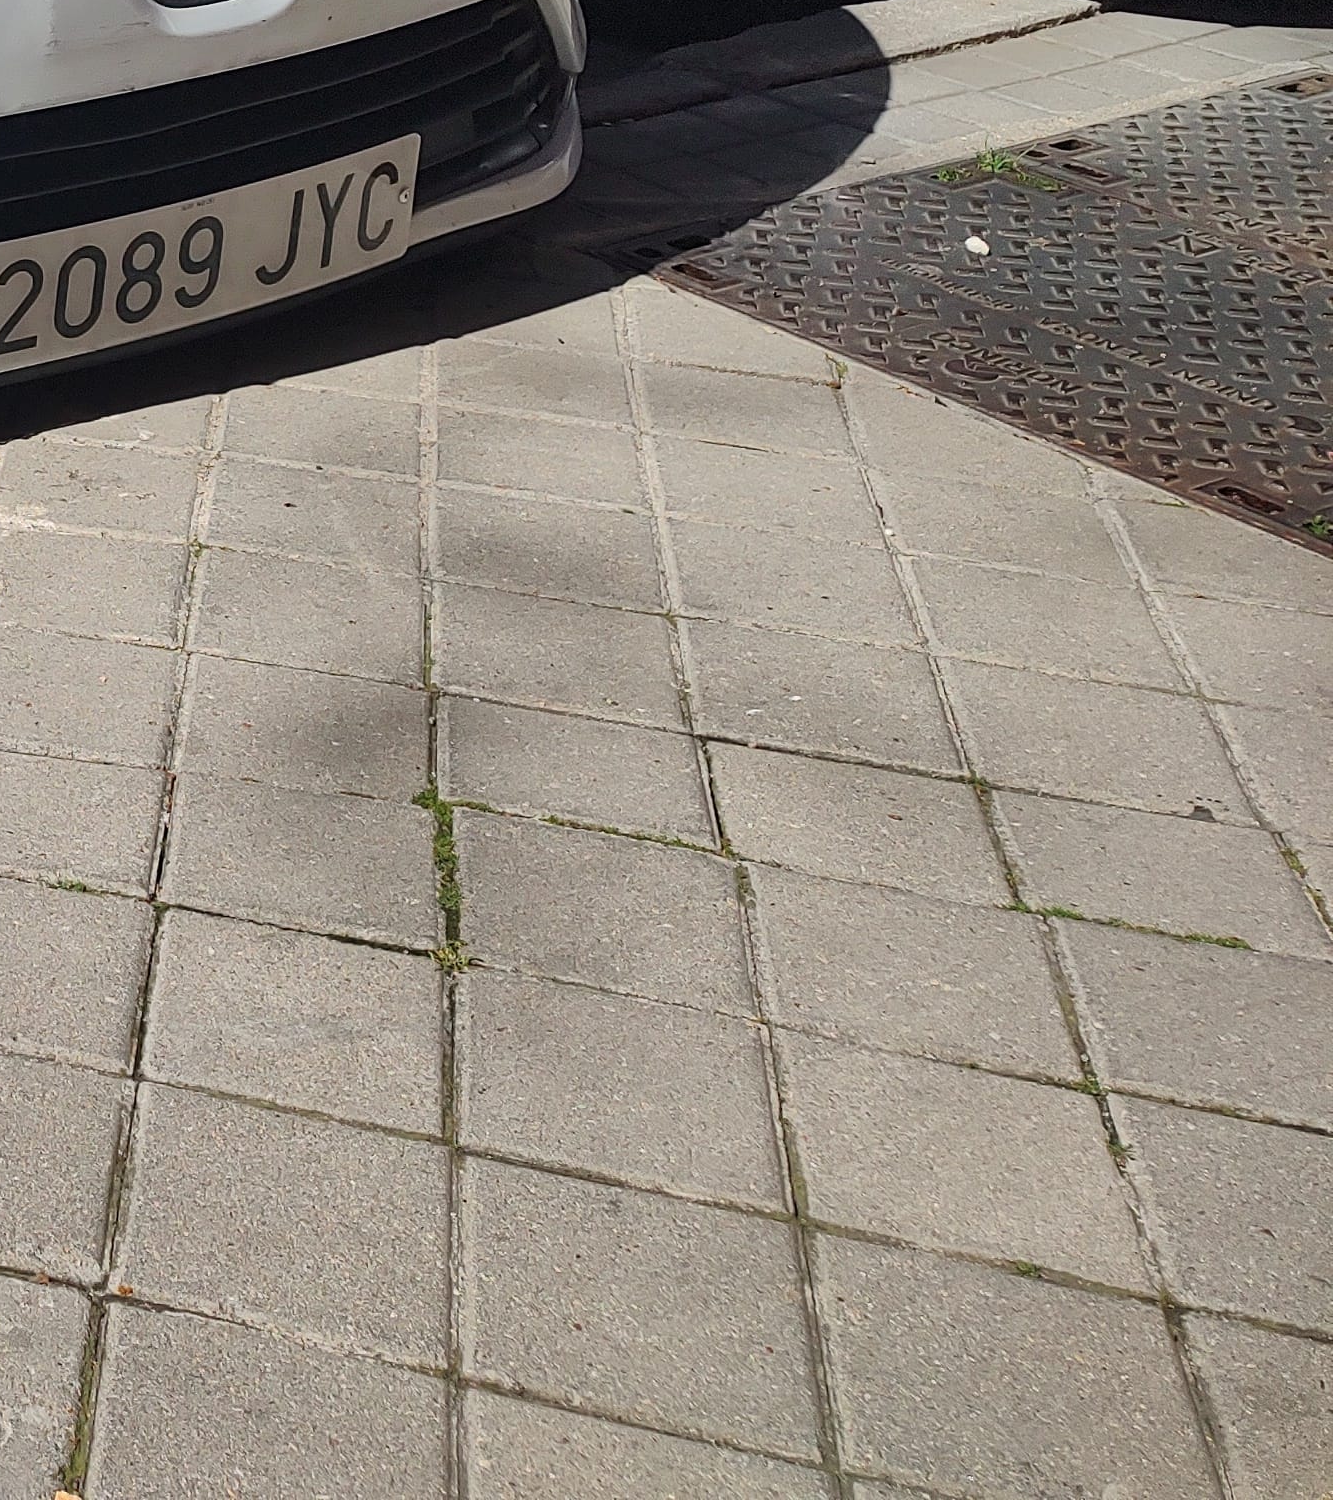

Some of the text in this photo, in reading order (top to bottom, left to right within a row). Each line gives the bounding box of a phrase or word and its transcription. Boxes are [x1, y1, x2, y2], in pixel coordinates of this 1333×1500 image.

[255, 161, 400, 286] JYC
[929, 331, 1084, 395] NORINCO
[1037, 316, 1166, 368] FENOSA
[1167, 368, 1279, 412] UNION
